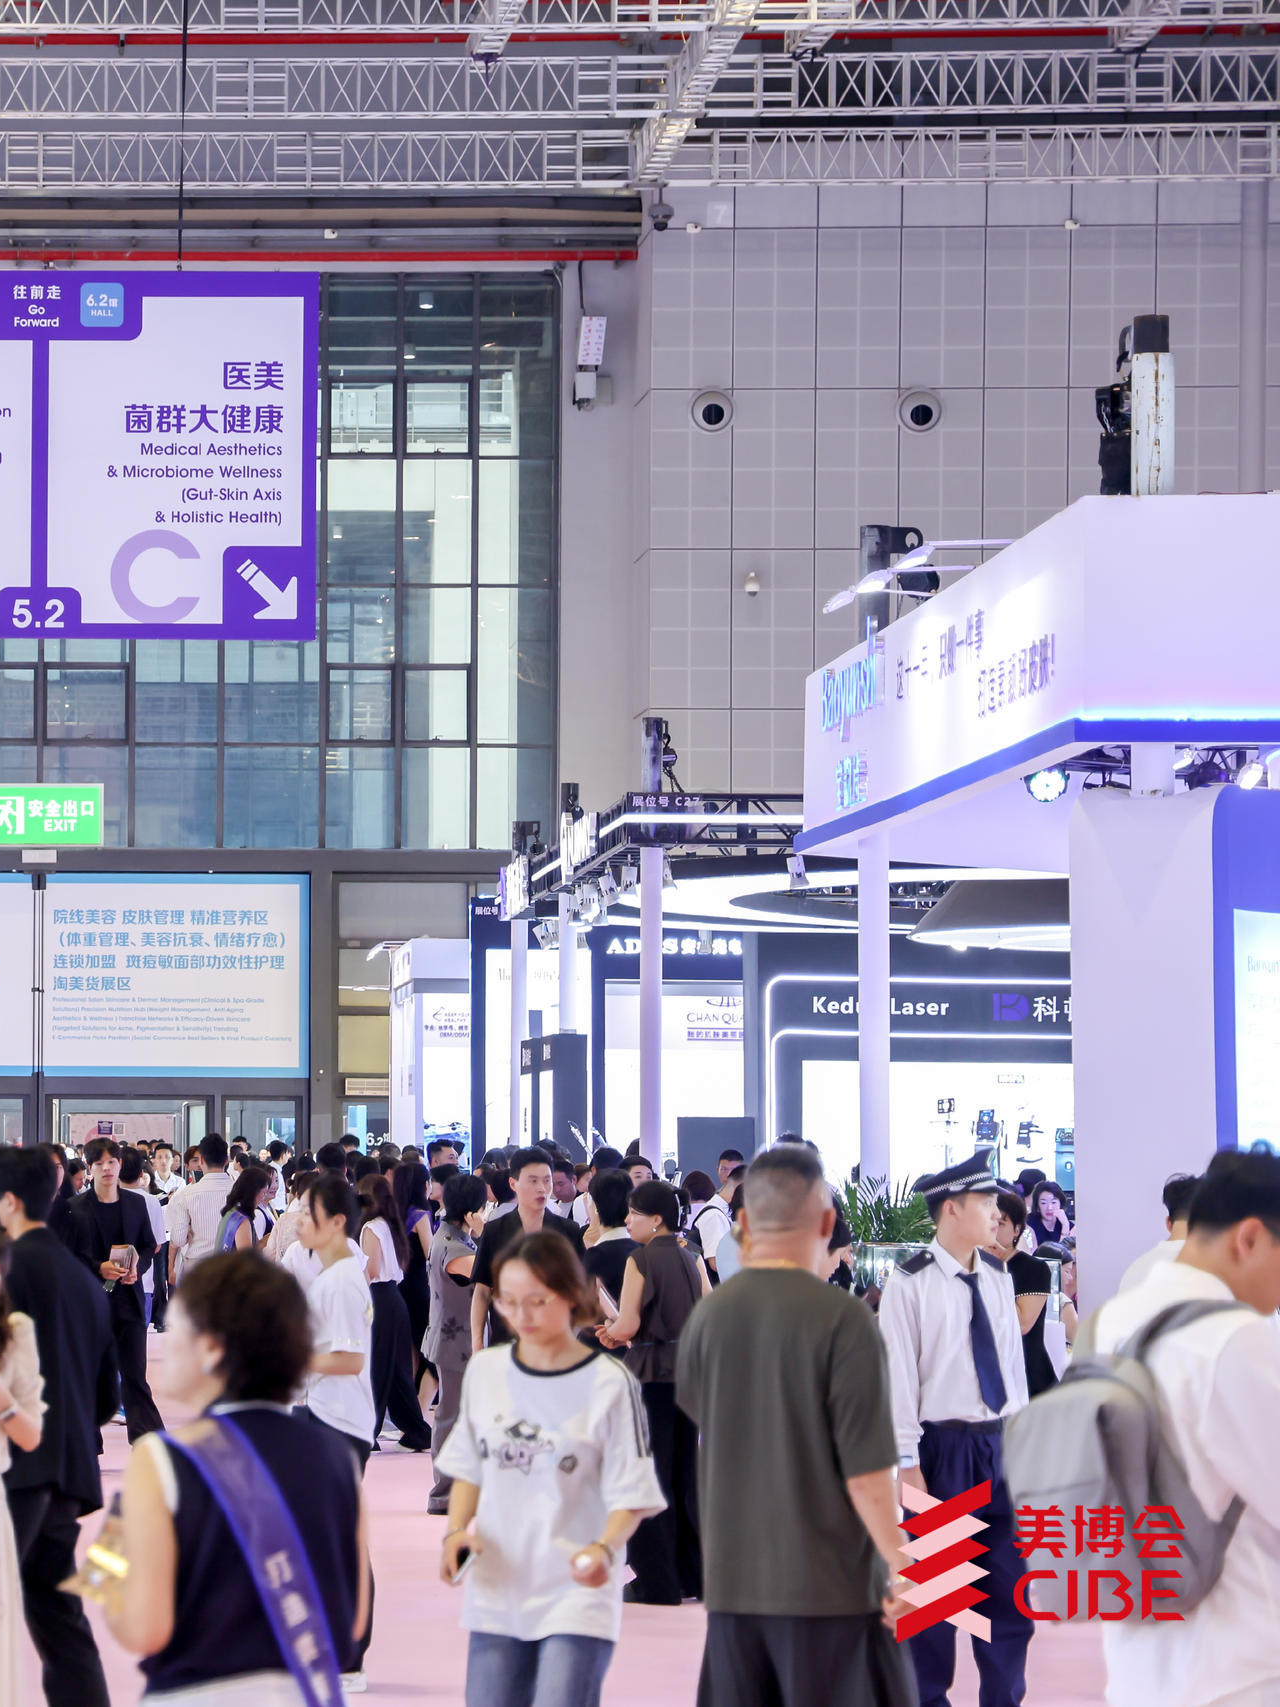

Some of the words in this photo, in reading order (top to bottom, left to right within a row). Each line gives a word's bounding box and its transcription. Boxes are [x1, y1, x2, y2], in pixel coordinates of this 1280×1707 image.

[12, 284, 62, 300] 往前走
[28, 304, 46, 316] Go
[90, 309, 113, 317] HALL
[14, 316, 60, 328] Forward
[222, 361, 284, 391] 医美
[124, 404, 284, 434] 菌群大健康
[140, 443, 202, 456] Medical
[206, 443, 282, 456] Aesthetics
[107, 466, 118, 478] &
[123, 466, 214, 478] Microbiome
[219, 466, 282, 478] Wellness
[181, 488, 248, 504] (Gut-Skin
[253, 488, 282, 501] Axis
[155, 511, 166, 524] &
[170, 510, 224, 524] Holistic
[228, 510, 282, 526] Health)
[110, 529, 200, 624] C
[12, 599, 64, 628] 5.2
[27, 800, 94, 818] 安全出口
[632, 795, 670, 807] 展位号
[675, 795, 700, 806] C27
[44, 818, 77, 833] EXIT
[53, 910, 116, 924] 院线美容
[122, 910, 185, 925] 皮肤管理
[190, 910, 269, 925] 精准营养区
[606, 936, 678, 955] ADS
[53, 954, 116, 970] 连锁加盟
[126, 954, 285, 970] 斑痘敏面部功效性护理
[53, 976, 132, 991] 淘美货展区
[890, 997, 950, 1016] Laser
